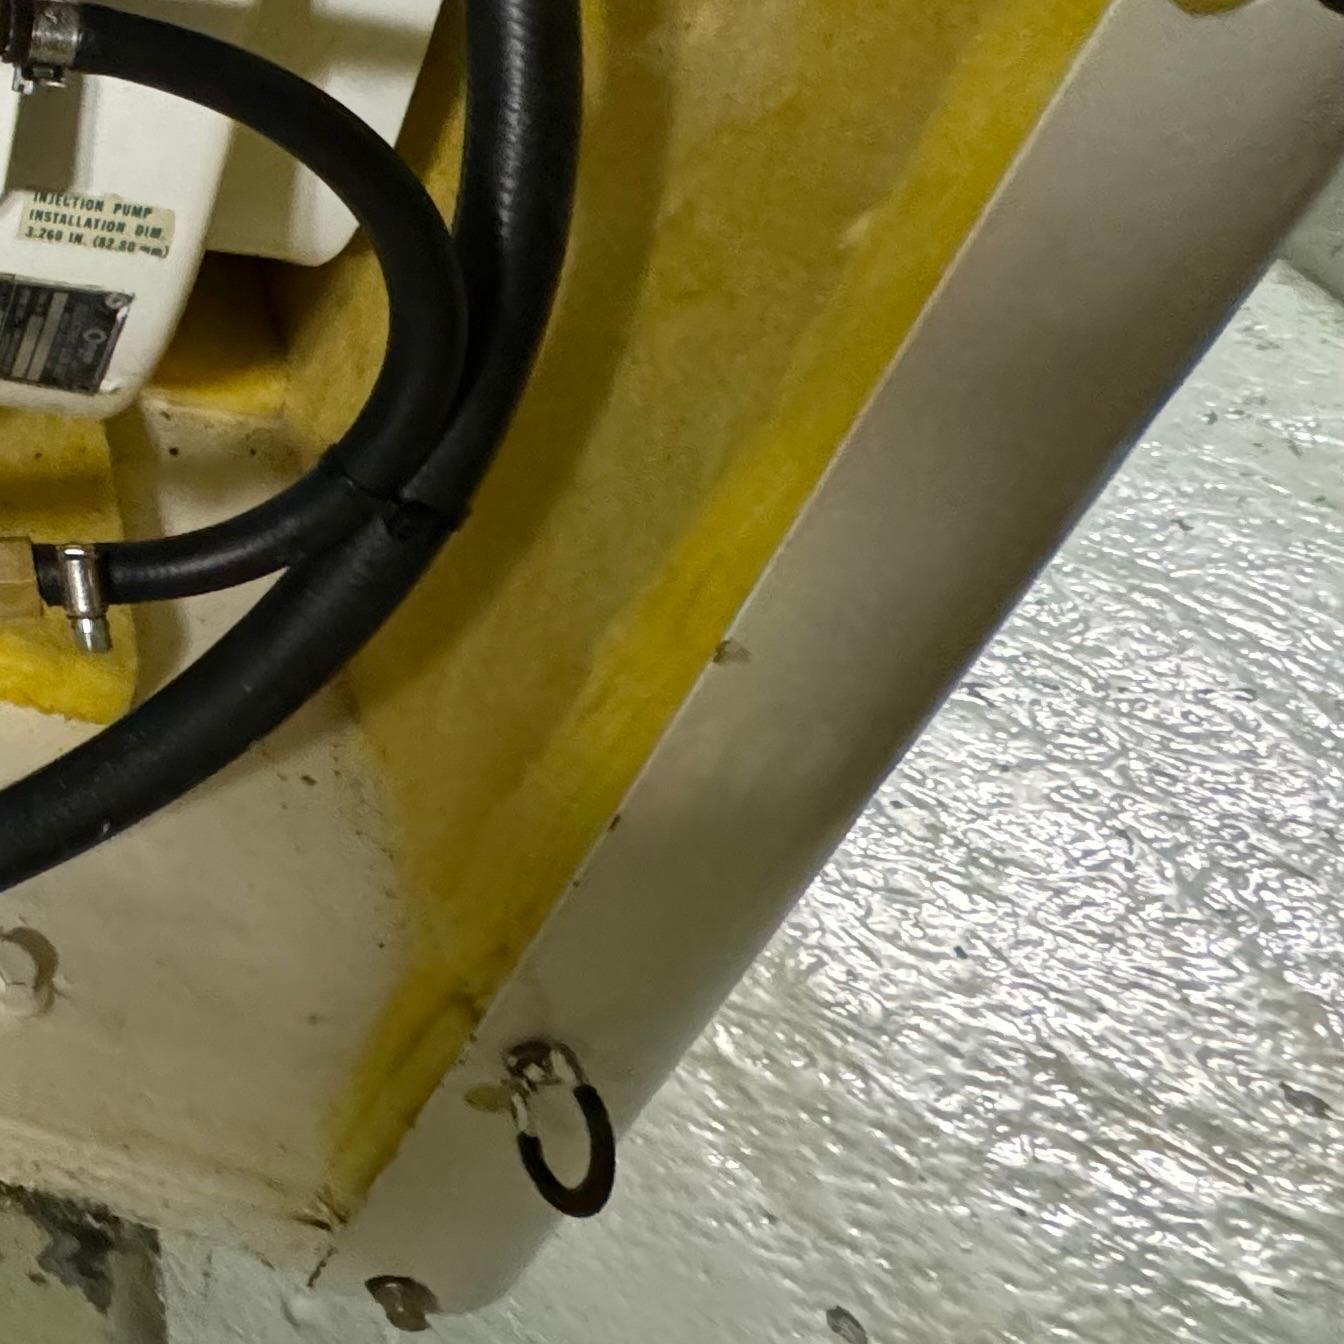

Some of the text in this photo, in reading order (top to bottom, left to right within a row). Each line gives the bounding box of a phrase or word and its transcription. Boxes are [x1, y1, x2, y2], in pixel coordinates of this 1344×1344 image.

[33, 192, 153, 219] INJECTION PUMP
[29, 209, 126, 234] INSTALLATION
